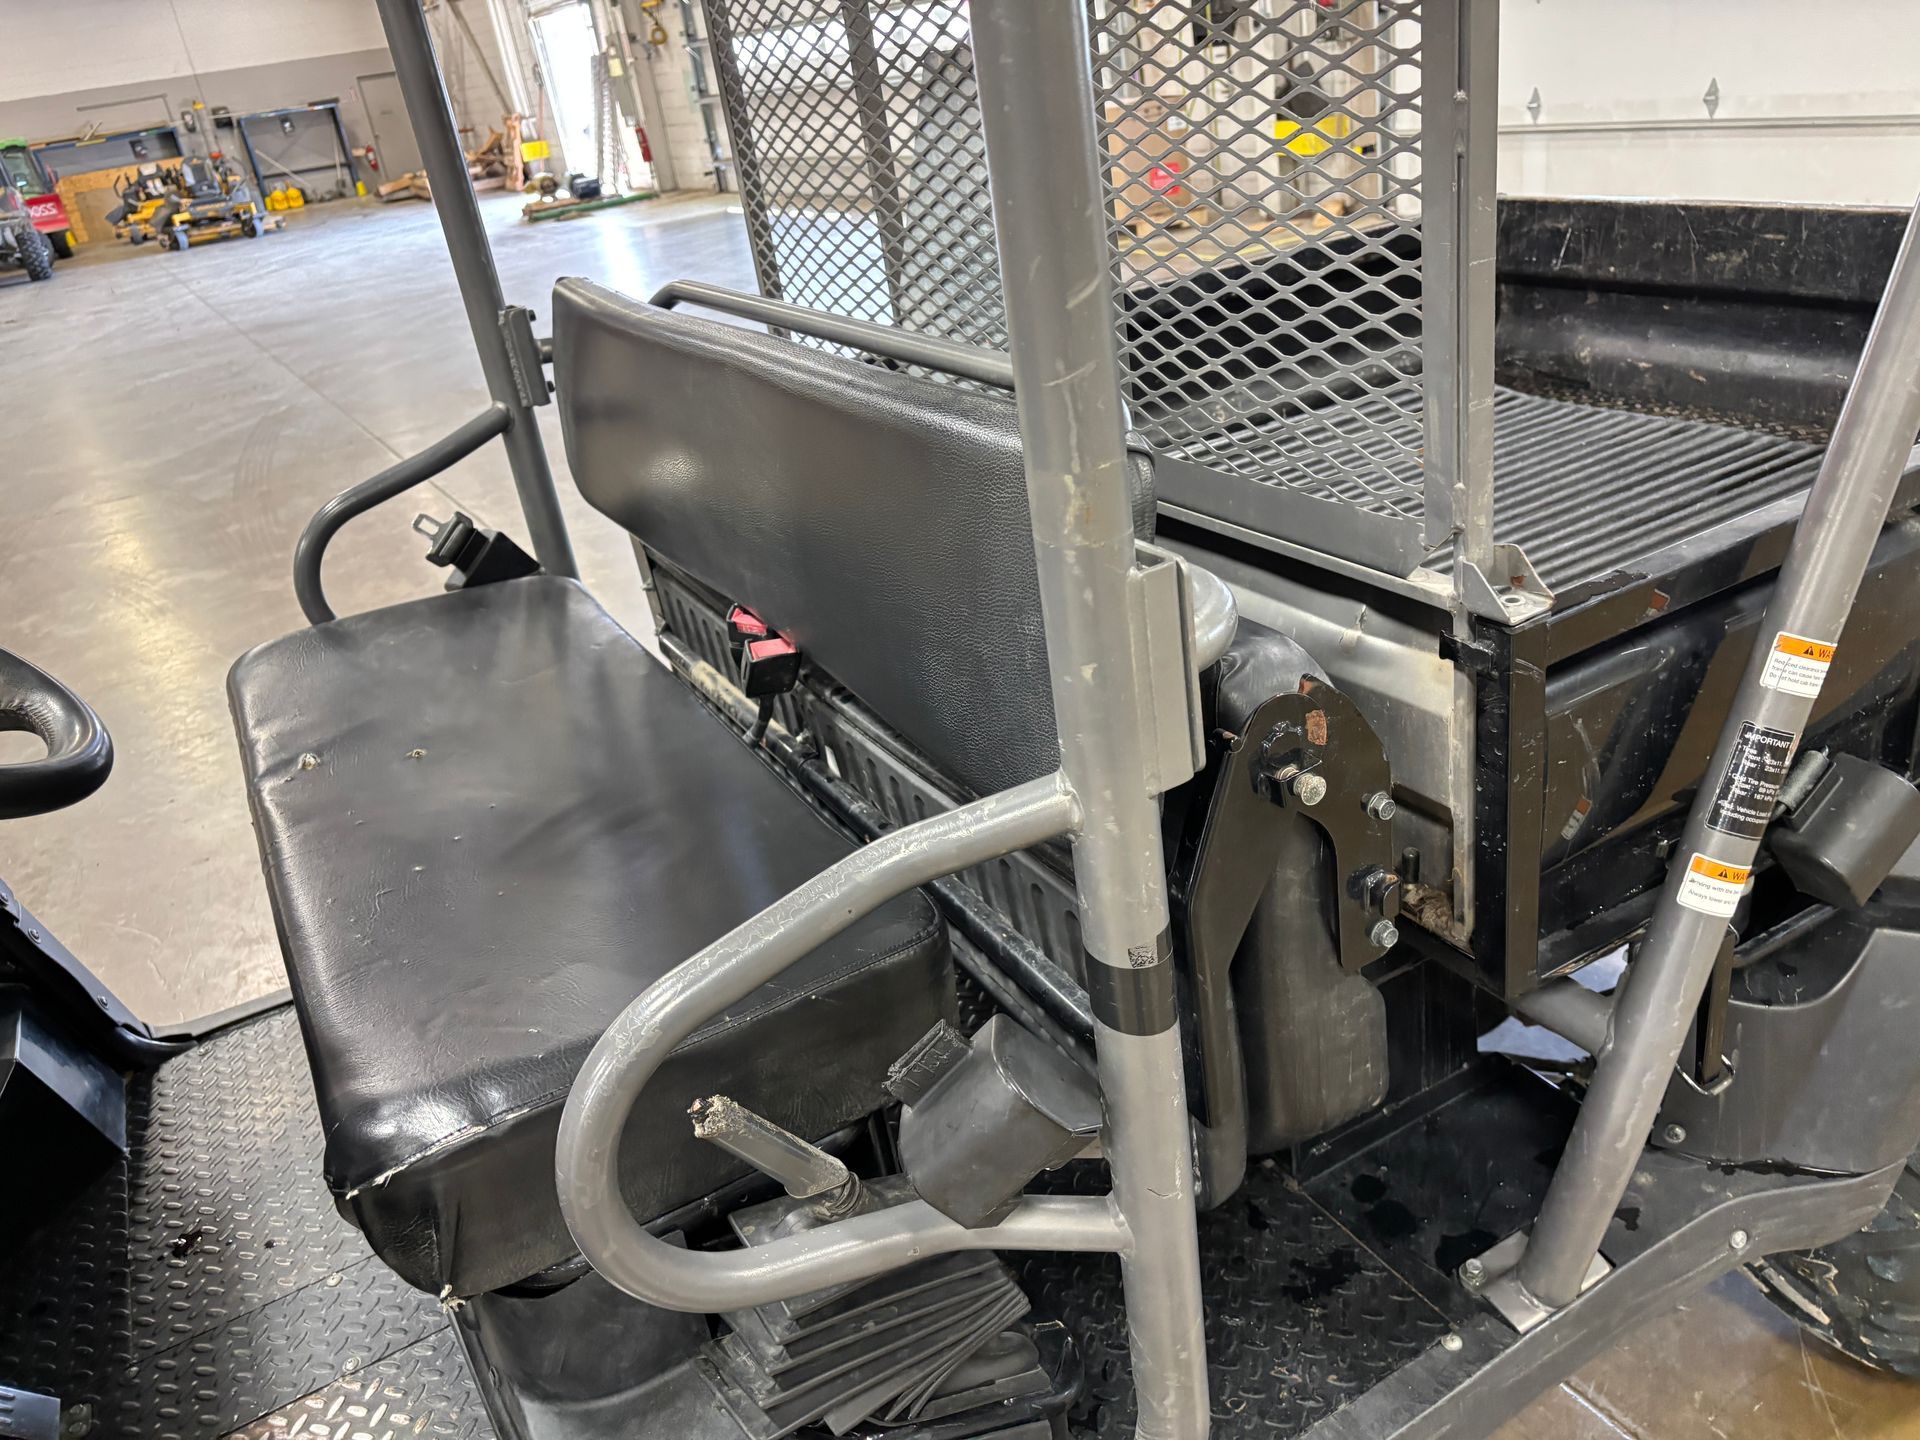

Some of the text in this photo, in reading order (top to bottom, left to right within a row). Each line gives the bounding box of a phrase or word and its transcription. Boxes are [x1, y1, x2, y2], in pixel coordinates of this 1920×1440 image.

[31, 202, 58, 217] OSS
[1745, 731, 1791, 749] IMPORTANT
[1736, 805, 1756, 816] Vehicle
[1688, 889, 1708, 900] Always
